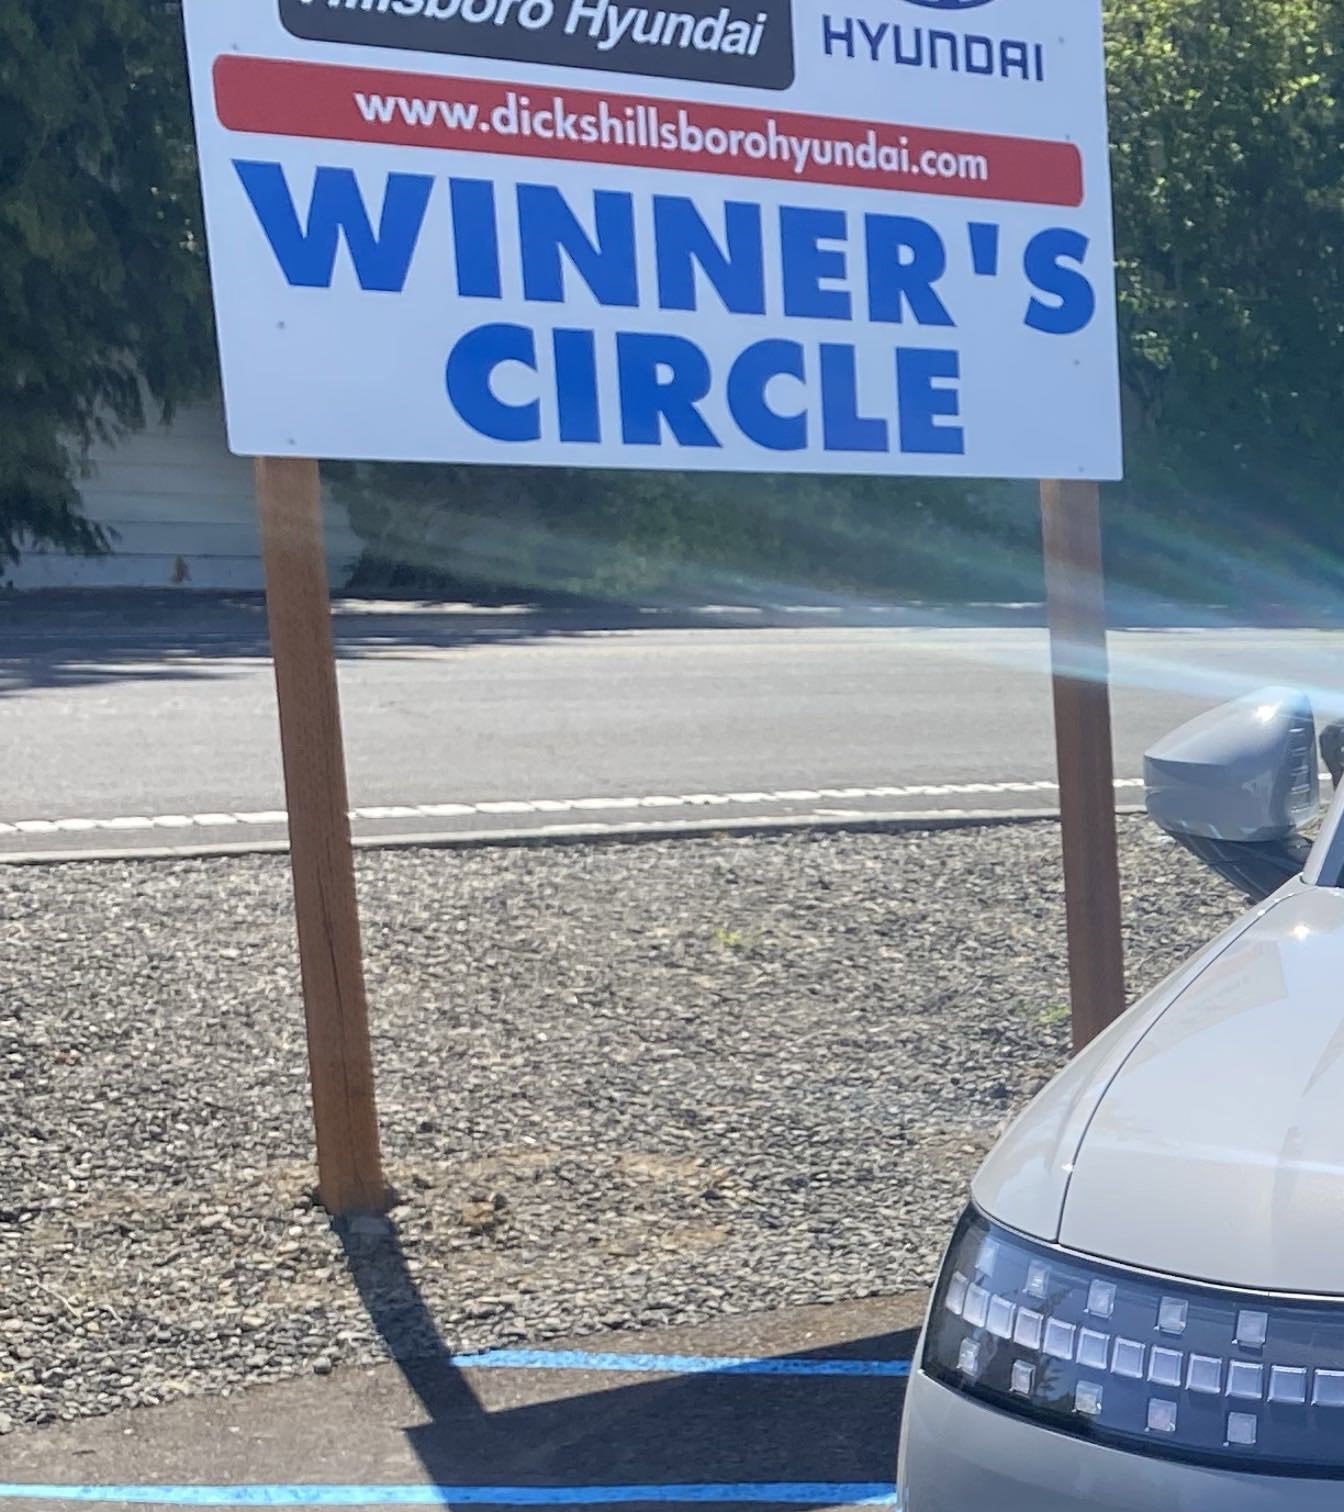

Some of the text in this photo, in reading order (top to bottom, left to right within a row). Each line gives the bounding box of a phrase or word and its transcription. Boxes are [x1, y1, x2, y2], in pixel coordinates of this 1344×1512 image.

[564, 0, 768, 56] Hyundai
[822, 14, 1044, 81] HYUNDAI
[353, 91, 988, 180] www.dickshillsborohyundai.com
[231, 158, 1096, 335] WINNER'S
[444, 322, 966, 455] CIRCLE
